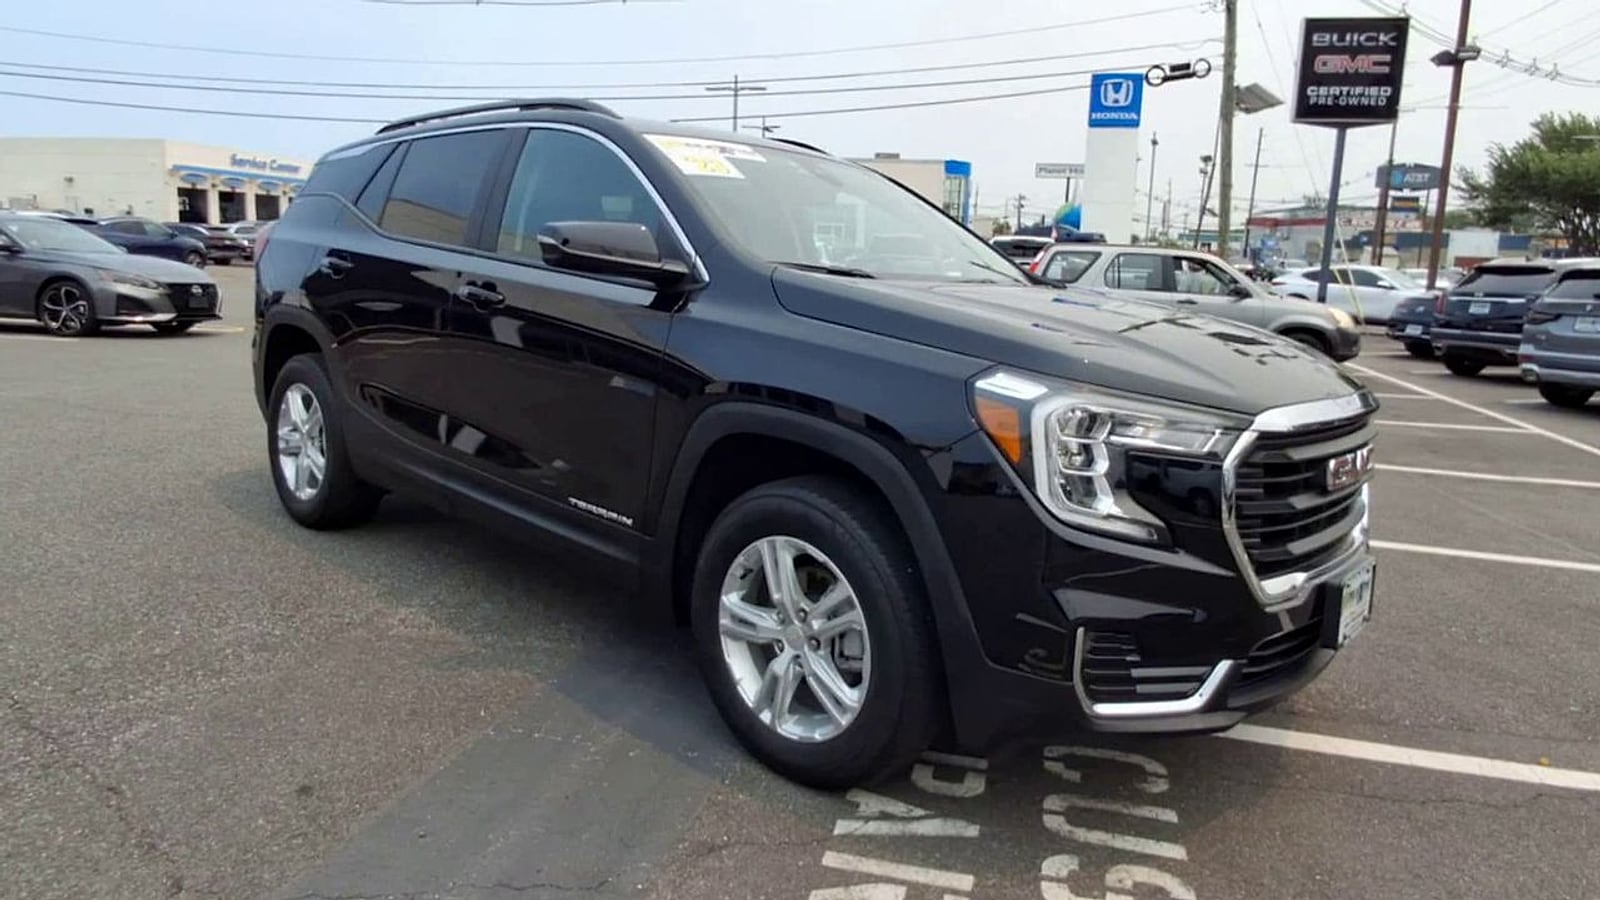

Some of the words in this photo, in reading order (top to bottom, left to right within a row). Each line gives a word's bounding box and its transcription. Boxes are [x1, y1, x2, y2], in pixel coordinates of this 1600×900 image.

[1312, 32, 1397, 46] BUICK
[1314, 54, 1391, 73] GMC
[1306, 85, 1392, 97] CERTIFIED
[1309, 96, 1387, 106] PRE-OWNED
[1091, 112, 1138, 120] HONDA
[1403, 172, 1431, 183] AT&T
[1327, 444, 1374, 491] GM
[568, 496, 633, 527] TERRAIN
